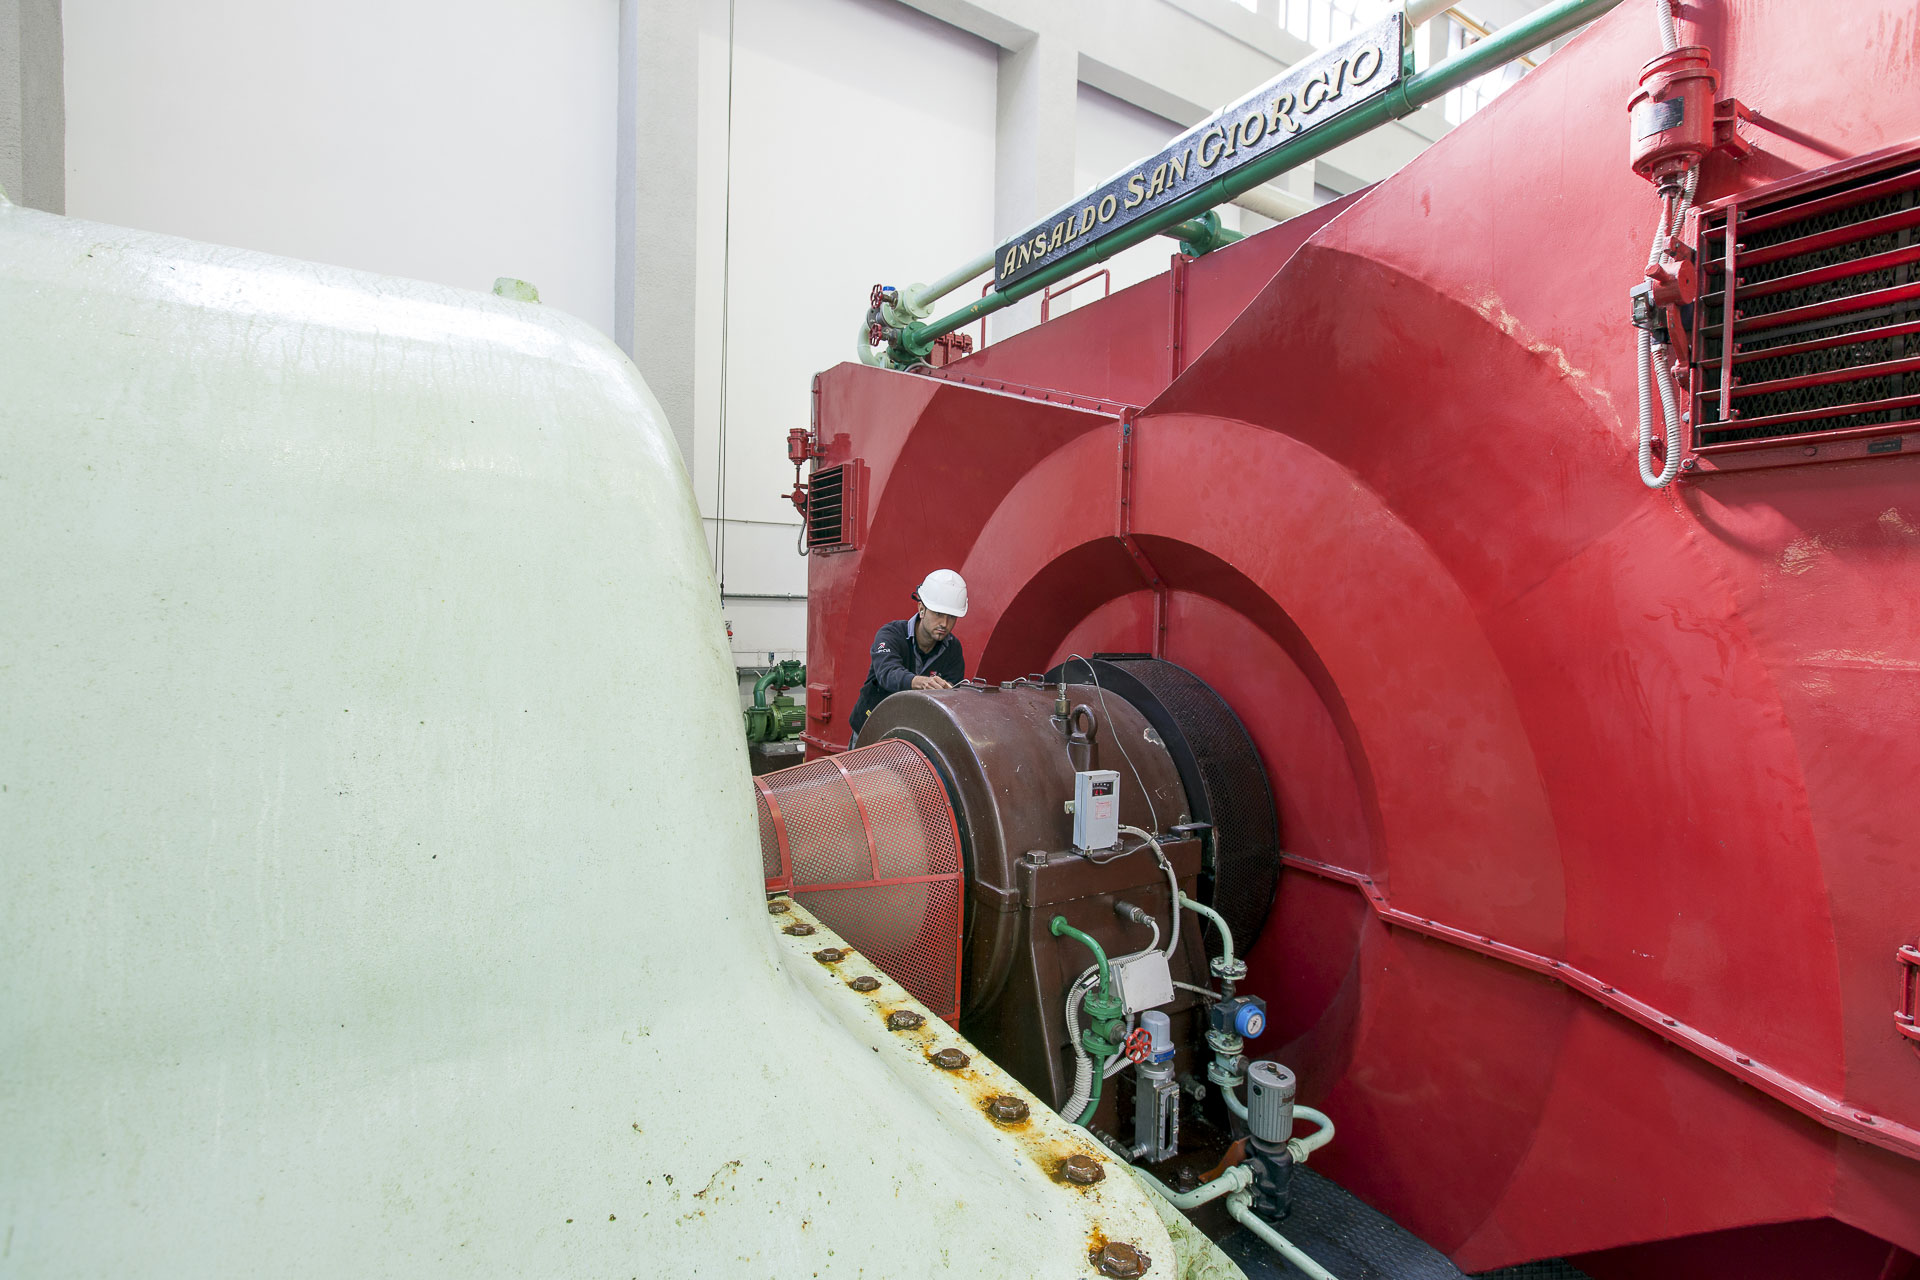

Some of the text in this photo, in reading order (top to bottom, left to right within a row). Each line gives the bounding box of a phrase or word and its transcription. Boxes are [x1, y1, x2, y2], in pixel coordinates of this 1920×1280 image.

[1000, 46, 1382, 280] ANSALDO SAN GIORGIO
